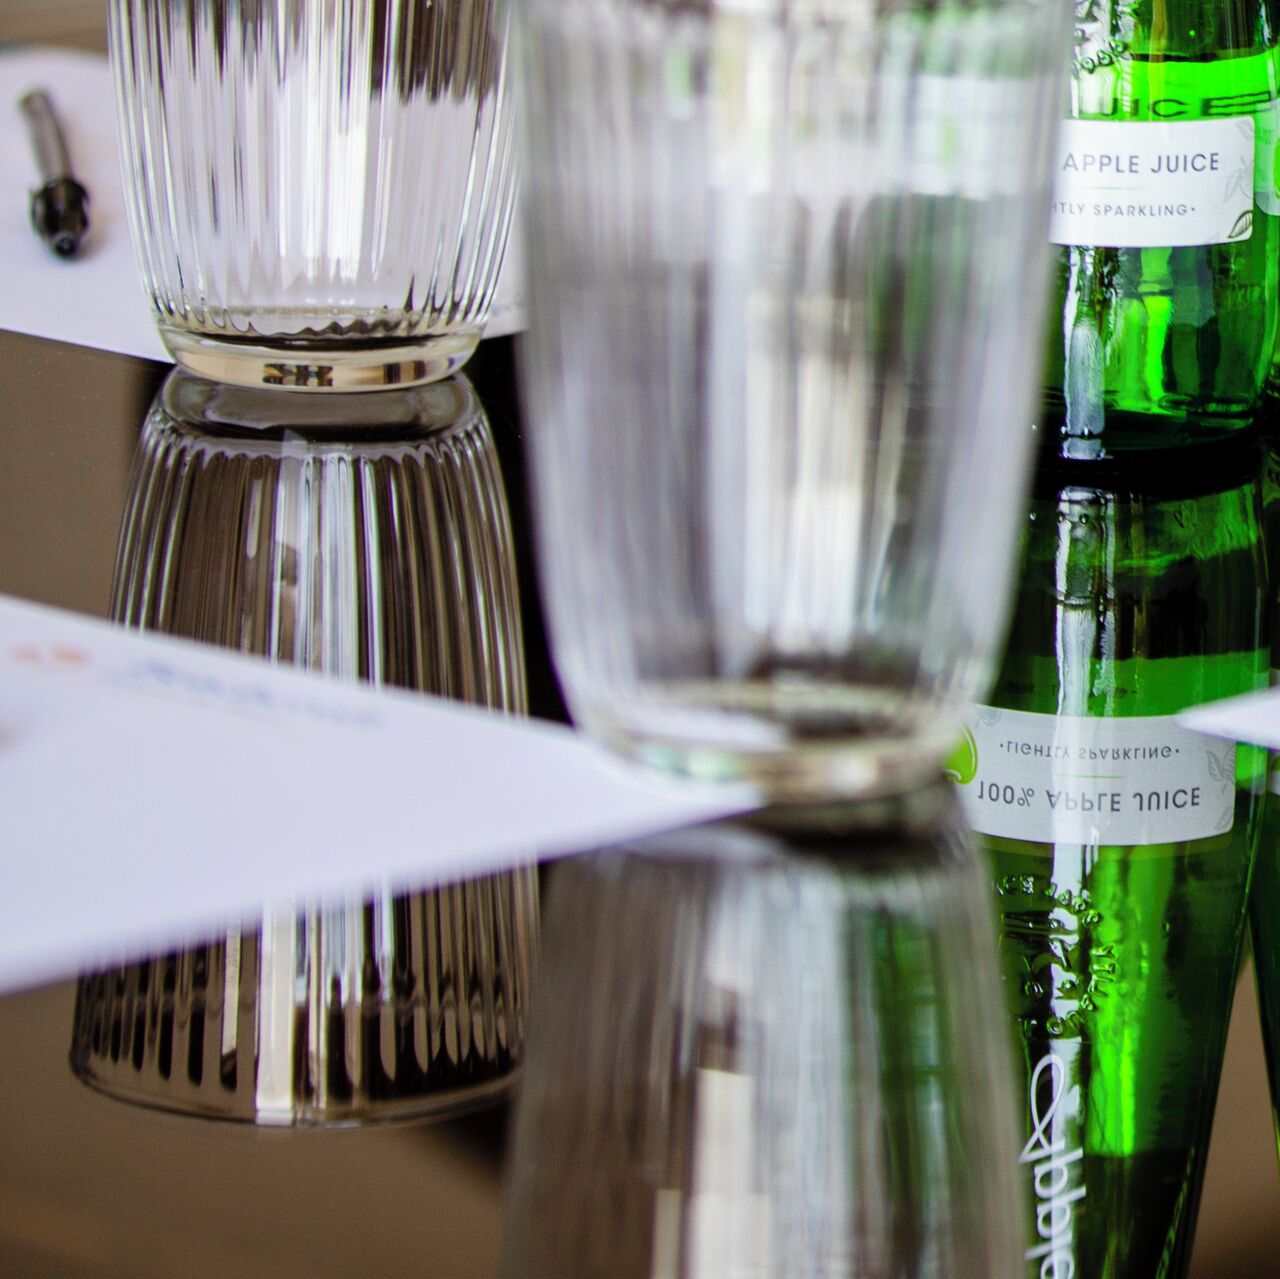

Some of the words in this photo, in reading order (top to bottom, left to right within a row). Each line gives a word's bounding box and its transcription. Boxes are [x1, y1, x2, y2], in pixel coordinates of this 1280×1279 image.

[1062, 152, 1139, 174] APPLE
[1150, 152, 1219, 173] JUICE
[1093, 202, 1188, 217] SPARKLING
